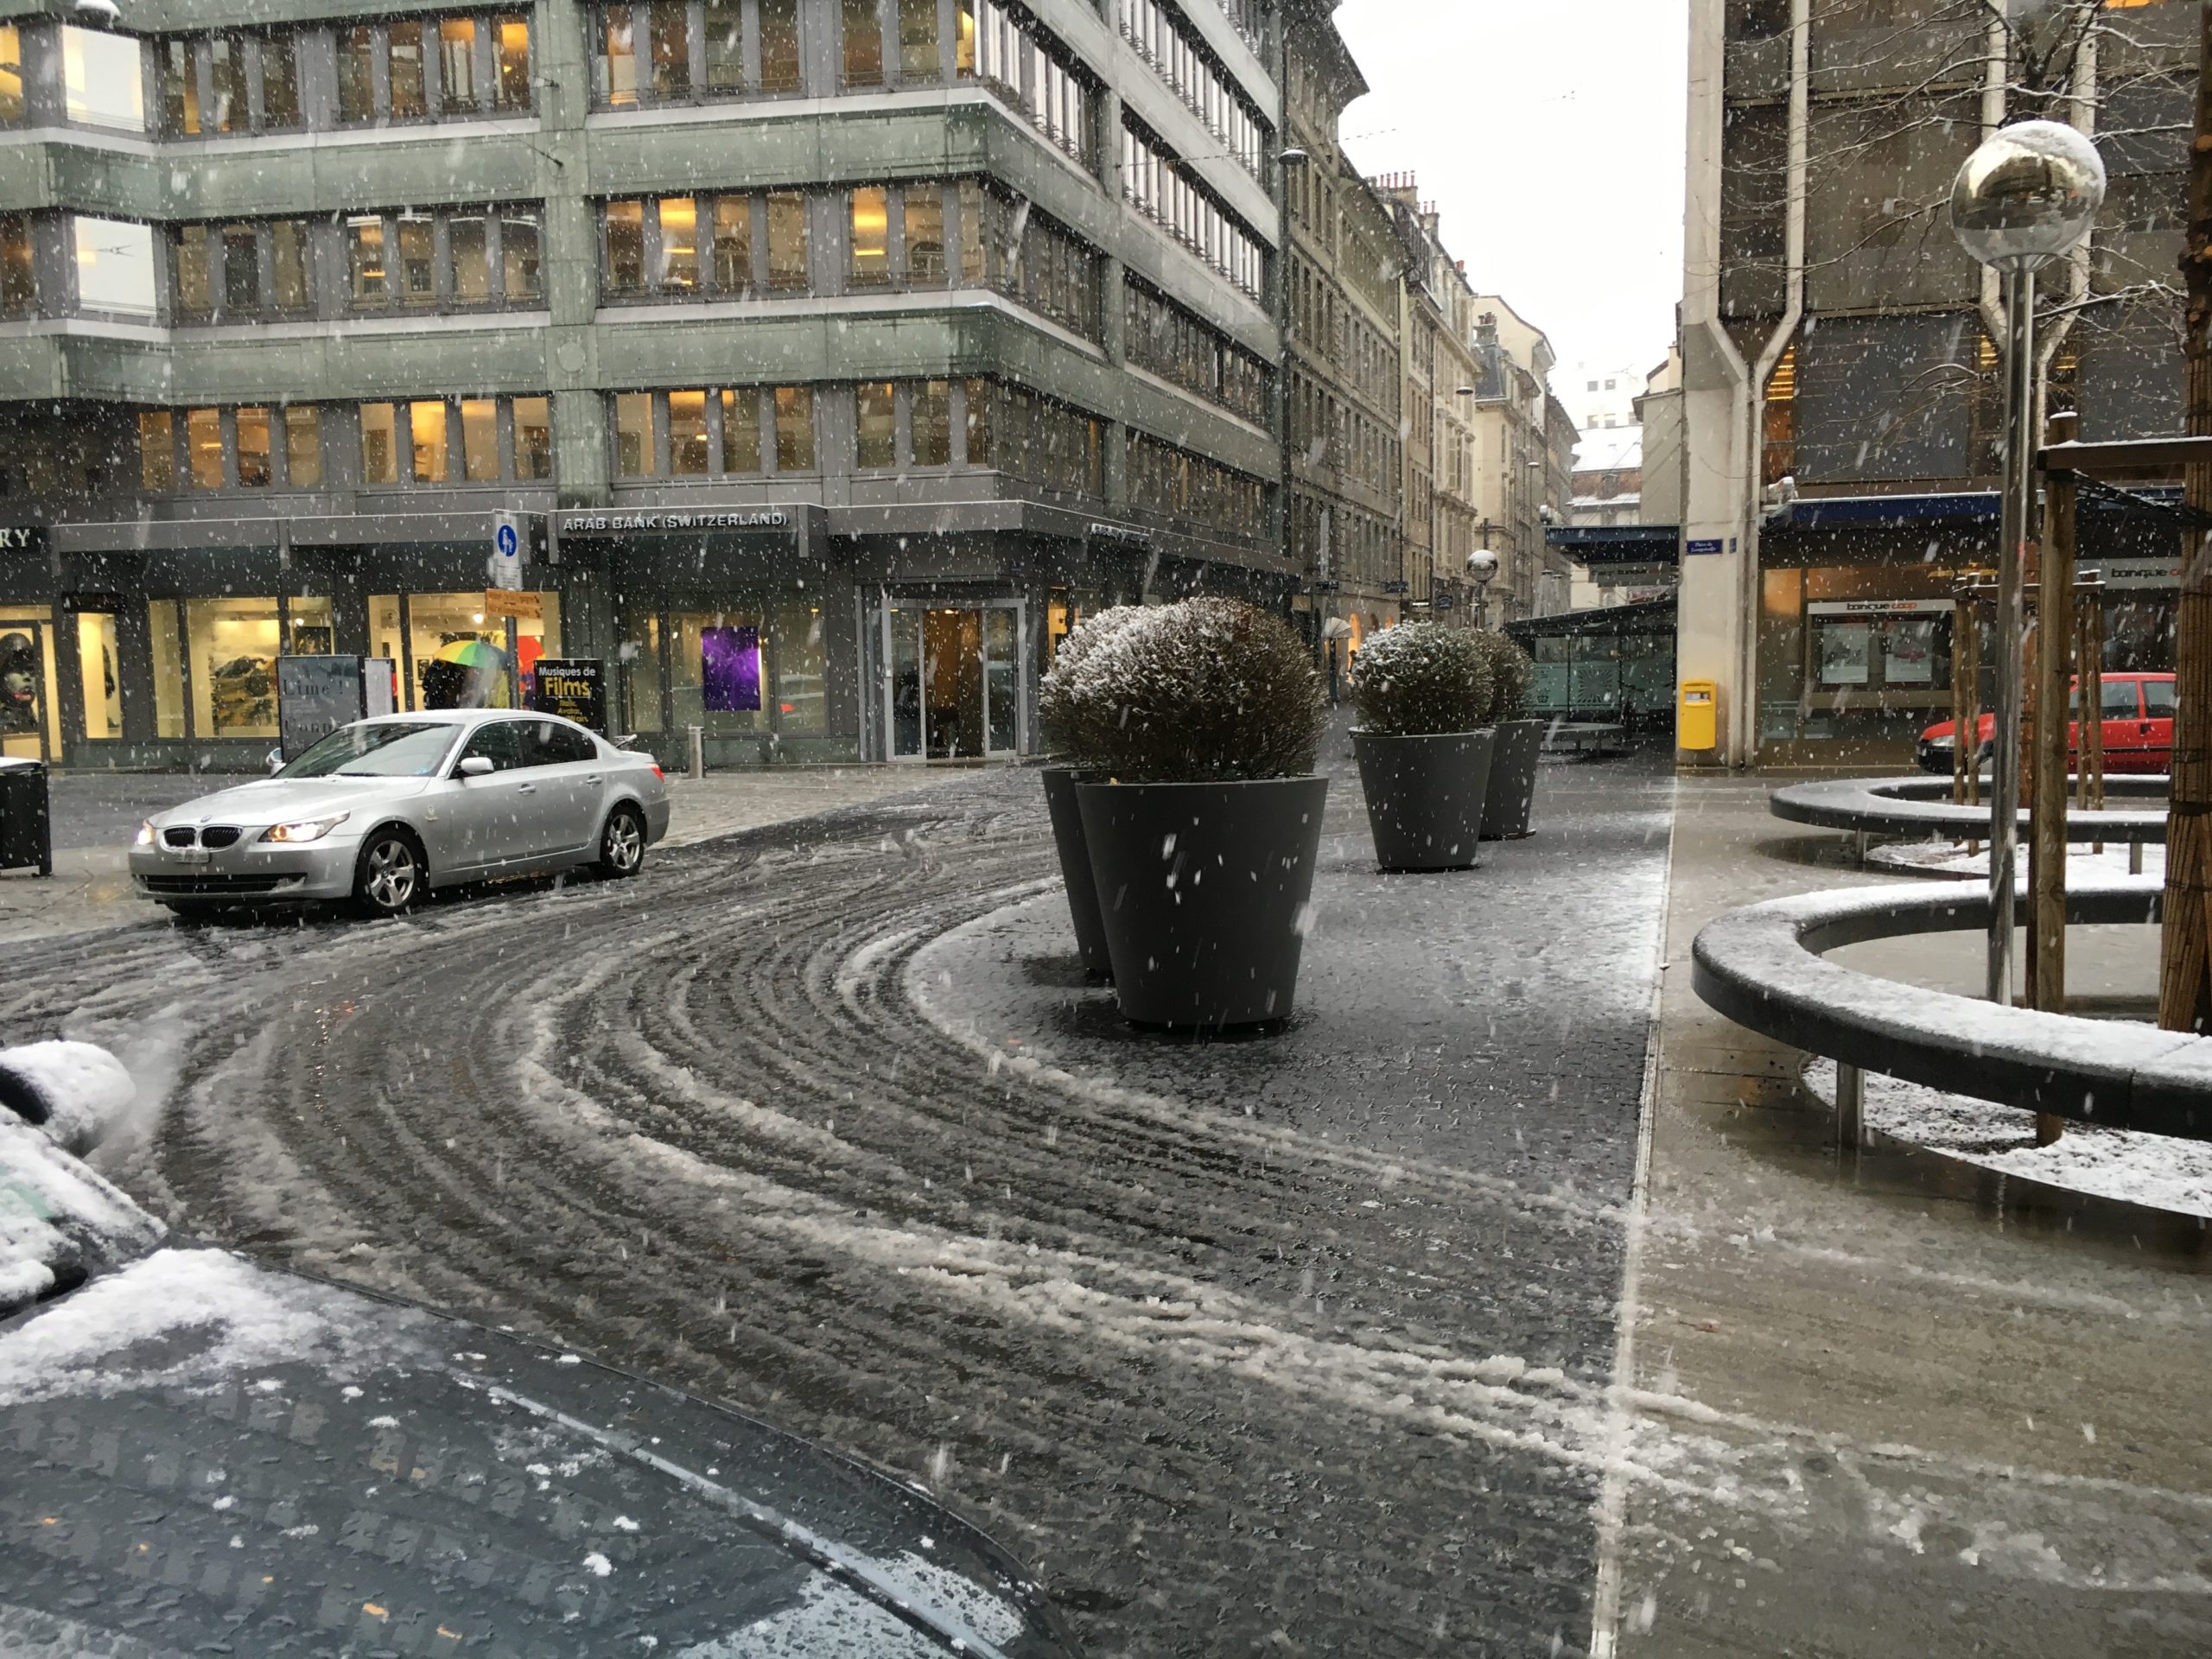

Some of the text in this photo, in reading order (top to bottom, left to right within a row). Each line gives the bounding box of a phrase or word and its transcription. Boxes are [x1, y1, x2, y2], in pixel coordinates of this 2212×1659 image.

[563, 512, 787, 531] ARAB BANK (SWITZERLAND)
[2111, 568, 2167, 579] banque
[1847, 602, 1890, 612] banque
[539, 666, 596, 678] Musiques de
[545, 677, 591, 696] Films
